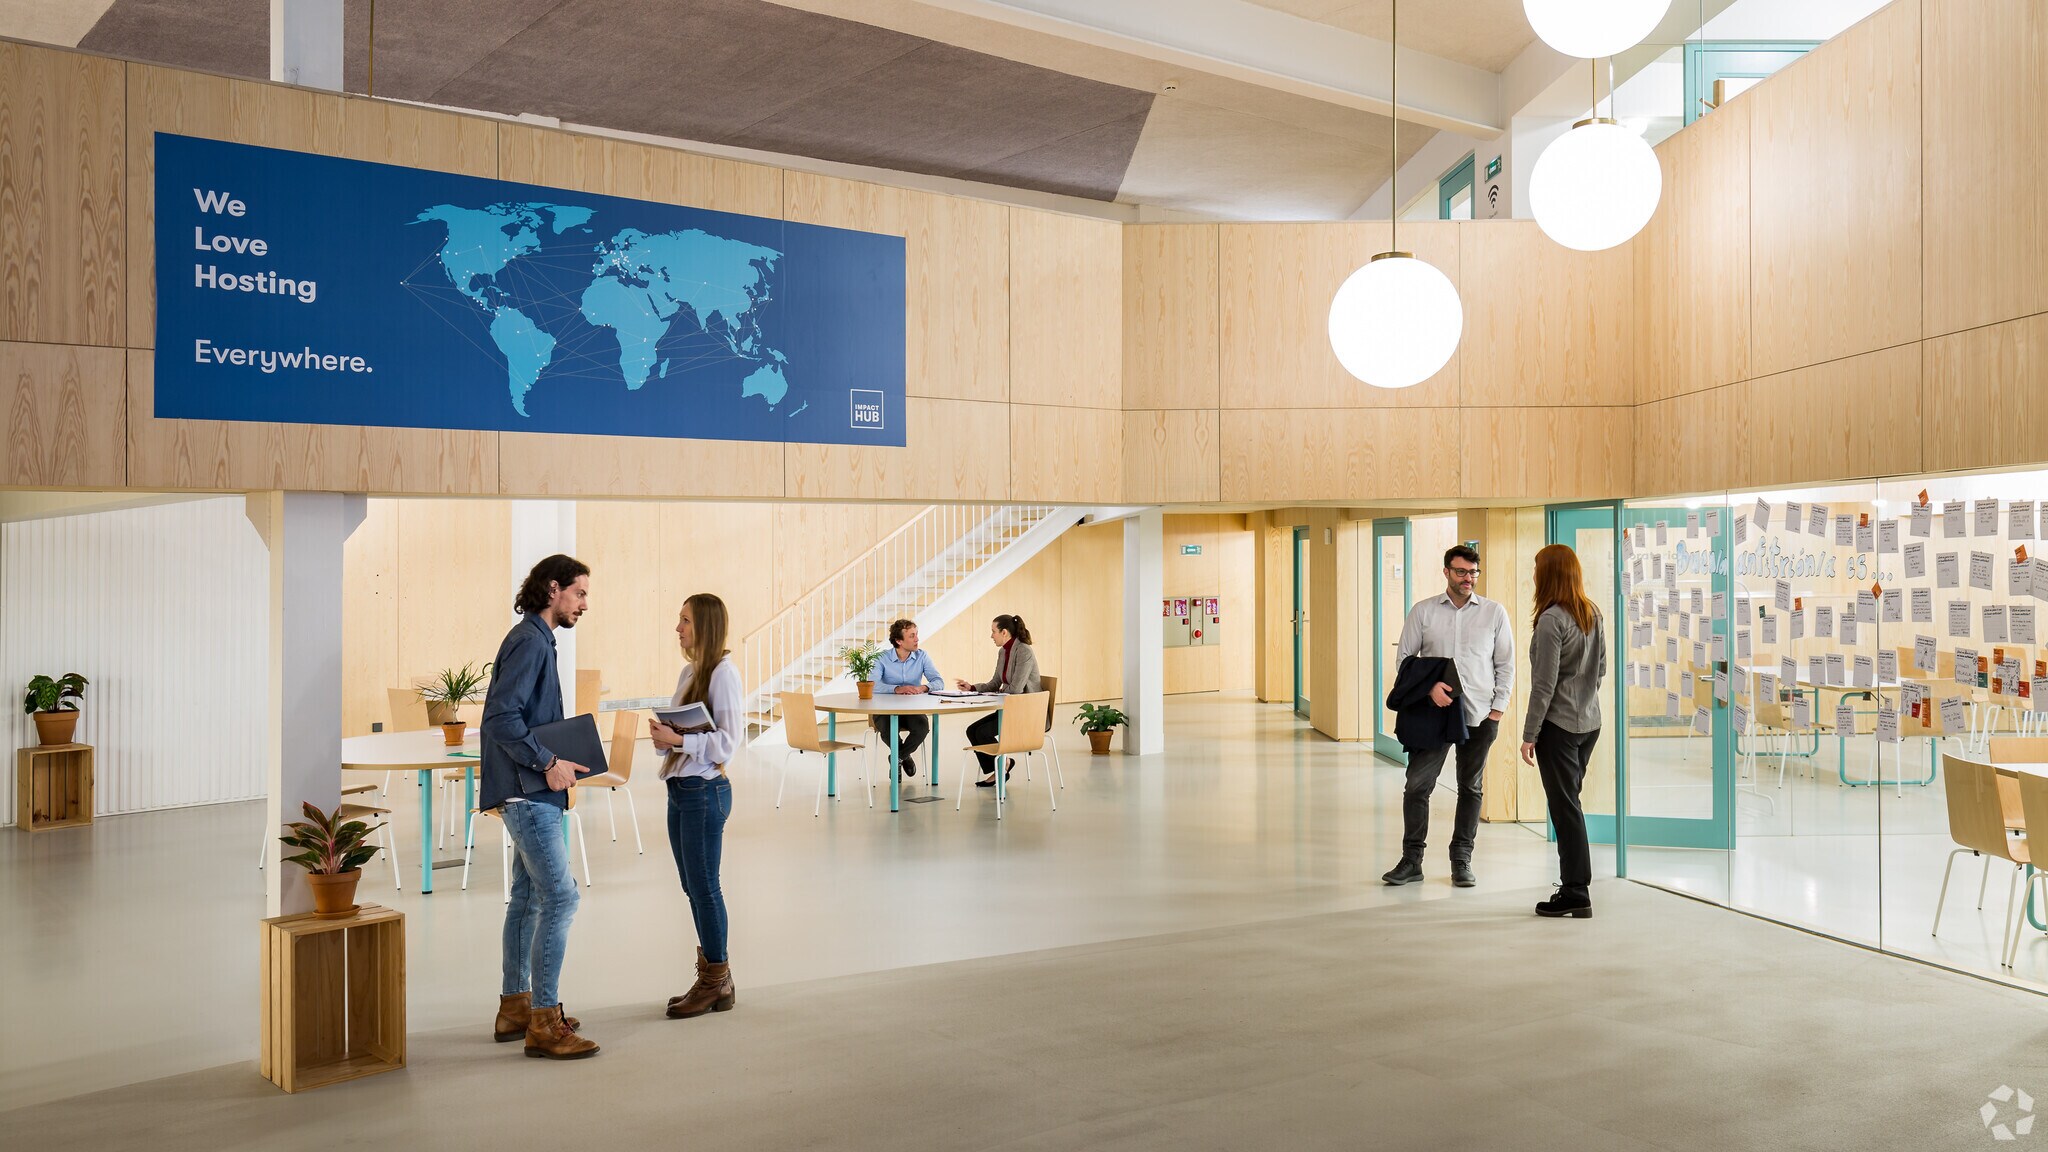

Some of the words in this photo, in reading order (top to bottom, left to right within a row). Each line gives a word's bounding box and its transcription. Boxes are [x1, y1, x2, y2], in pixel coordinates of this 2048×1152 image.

[194, 188, 246, 217] We
[195, 227, 268, 257] Love
[195, 264, 317, 304] Hosting
[195, 339, 373, 374] Everywhere.
[855, 410, 880, 423] HUB
